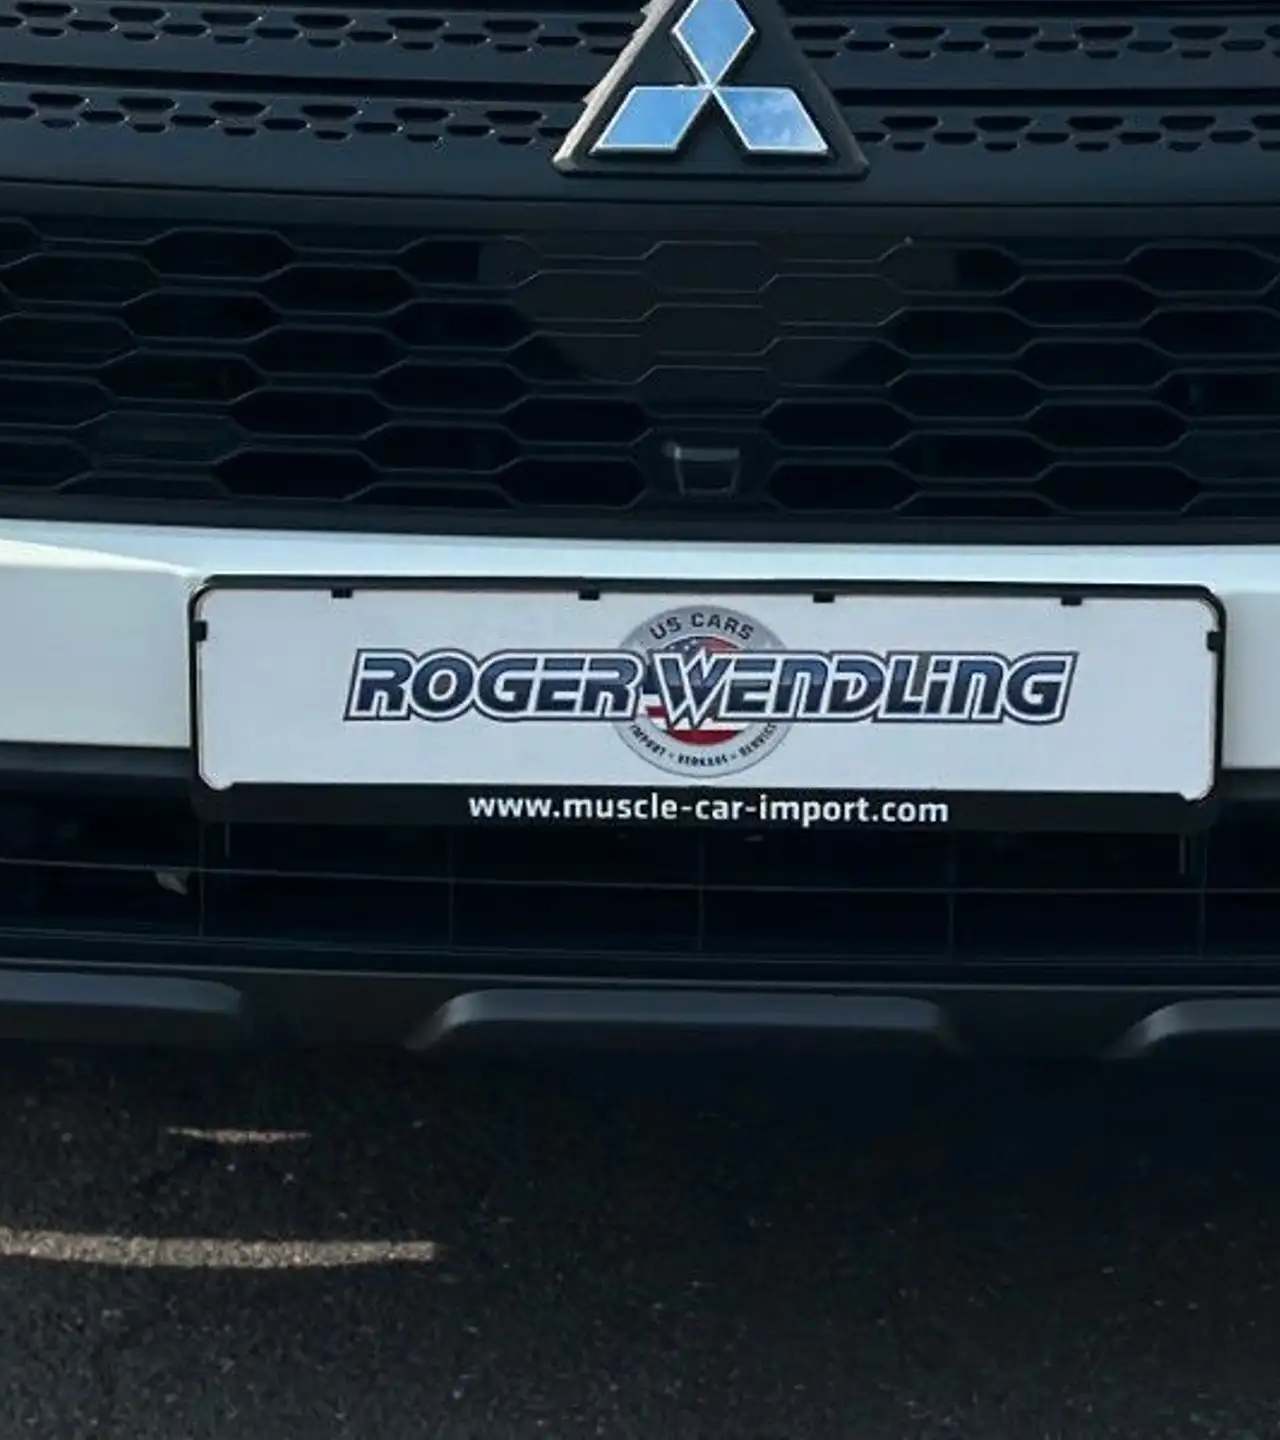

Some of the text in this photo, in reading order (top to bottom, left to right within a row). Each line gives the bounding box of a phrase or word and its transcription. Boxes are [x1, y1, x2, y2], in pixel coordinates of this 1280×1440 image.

[649, 611, 754, 641] US CARS
[344, 647, 1078, 729] ROGER WENDLING
[468, 792, 950, 827] www.muscle-car-import.com
